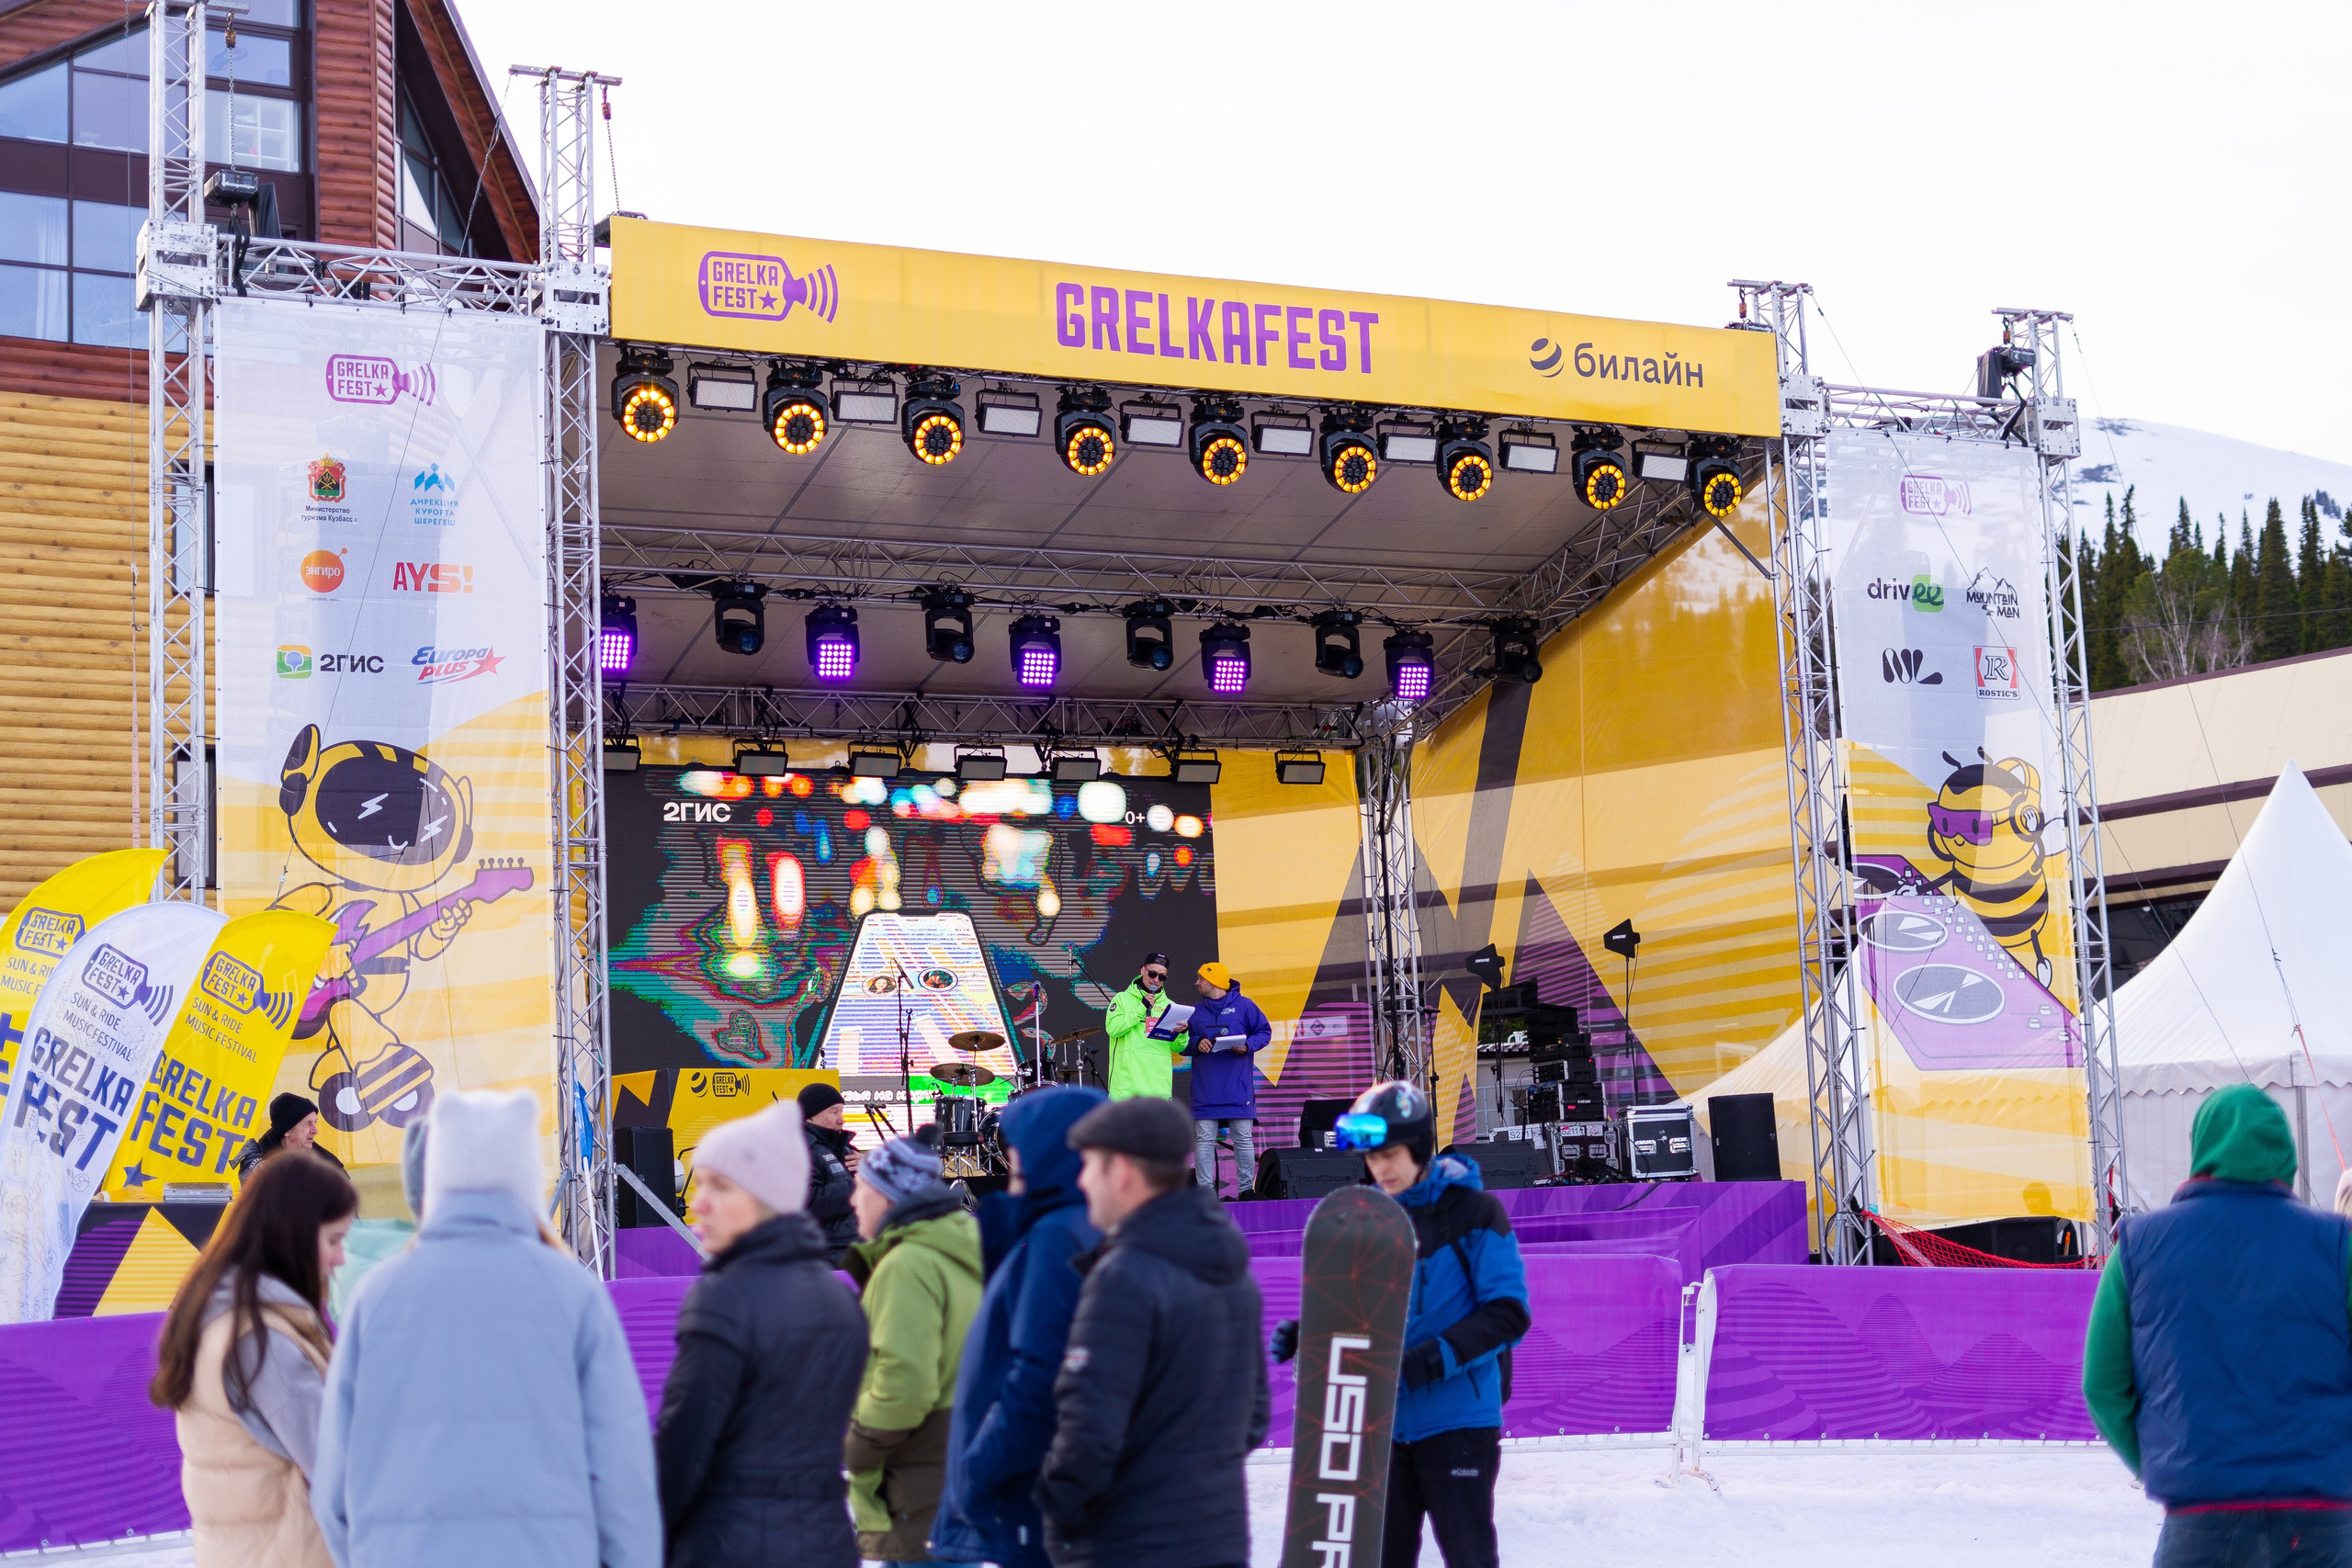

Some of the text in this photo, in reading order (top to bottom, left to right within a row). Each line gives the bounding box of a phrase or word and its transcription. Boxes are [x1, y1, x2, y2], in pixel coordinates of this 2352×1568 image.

[712, 261, 778, 286] GRELKA
[713, 286, 758, 310] FEST
[1056, 282, 1380, 375] GRELKAFEST
[337, 361, 390, 379] GRELKA
[1574, 343, 1704, 389] билайн
[337, 380, 372, 397] FEST
[1908, 481, 1942, 495] GRELKA
[305, 505, 350, 514] Министерство
[411, 499, 458, 508] ДИРЕКЦИЯ
[415, 508, 455, 516] КУРОРТА
[1909, 496, 1931, 508] FEST
[328, 515, 357, 524] Кузбасса
[414, 518, 456, 526] ШЕРЕГЕШ
[393, 562, 473, 593] AYS!
[1867, 578, 1945, 606] drivee
[1966, 592, 2018, 606] MOUNTAIN
[1997, 606, 2020, 618] MAN
[320, 653, 384, 673] 2ГИС
[663, 802, 731, 822] 2ГИС
[1125, 811, 1146, 824] 0+
[29, 914, 76, 935] GRELKA
[23, 930, 55, 948] FEST
[6, 956, 28, 972] SUN
[28, 963, 37, 975] &
[98, 951, 141, 986] GRELKA
[215, 958, 257, 991] GRELKA
[1, 975, 34, 995] MUSIC
[88, 967, 121, 993] FEST
[207, 973, 237, 998] FEST
[70, 992, 121, 1031] SUN & RIDE
[192, 998, 243, 1034] SUN & RIDE
[62, 1010, 131, 1062] MUSIC FESTIVAL
[186, 1013, 257, 1063] MUSIC FESTIVAL
[30, 1026, 136, 1117] GRELKA
[716, 1076, 734, 1084] GRELKA
[149, 1049, 257, 1129] GRELKA
[716, 1085, 729, 1093] FEST
[14, 1070, 119, 1171] FEST
[130, 1091, 246, 1174] FEST
[1319, 1337, 1371, 1481] USD
